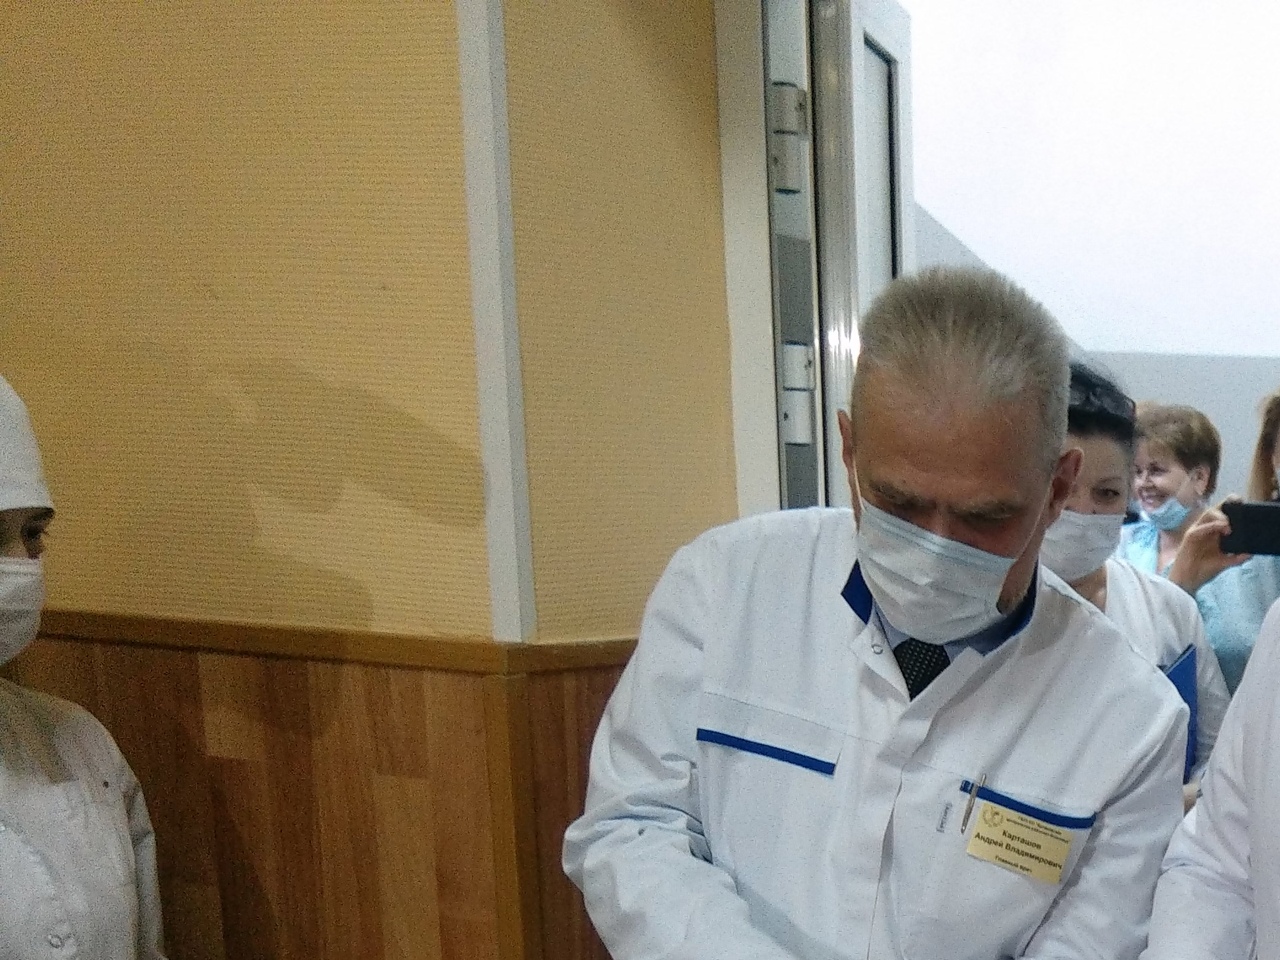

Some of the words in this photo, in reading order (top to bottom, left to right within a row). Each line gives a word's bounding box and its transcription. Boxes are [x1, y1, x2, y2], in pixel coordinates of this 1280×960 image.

[974, 832, 1004, 849] Андрей
[1005, 843, 1062, 870] Владимирович
[1002, 830, 1042, 850] Карташов
